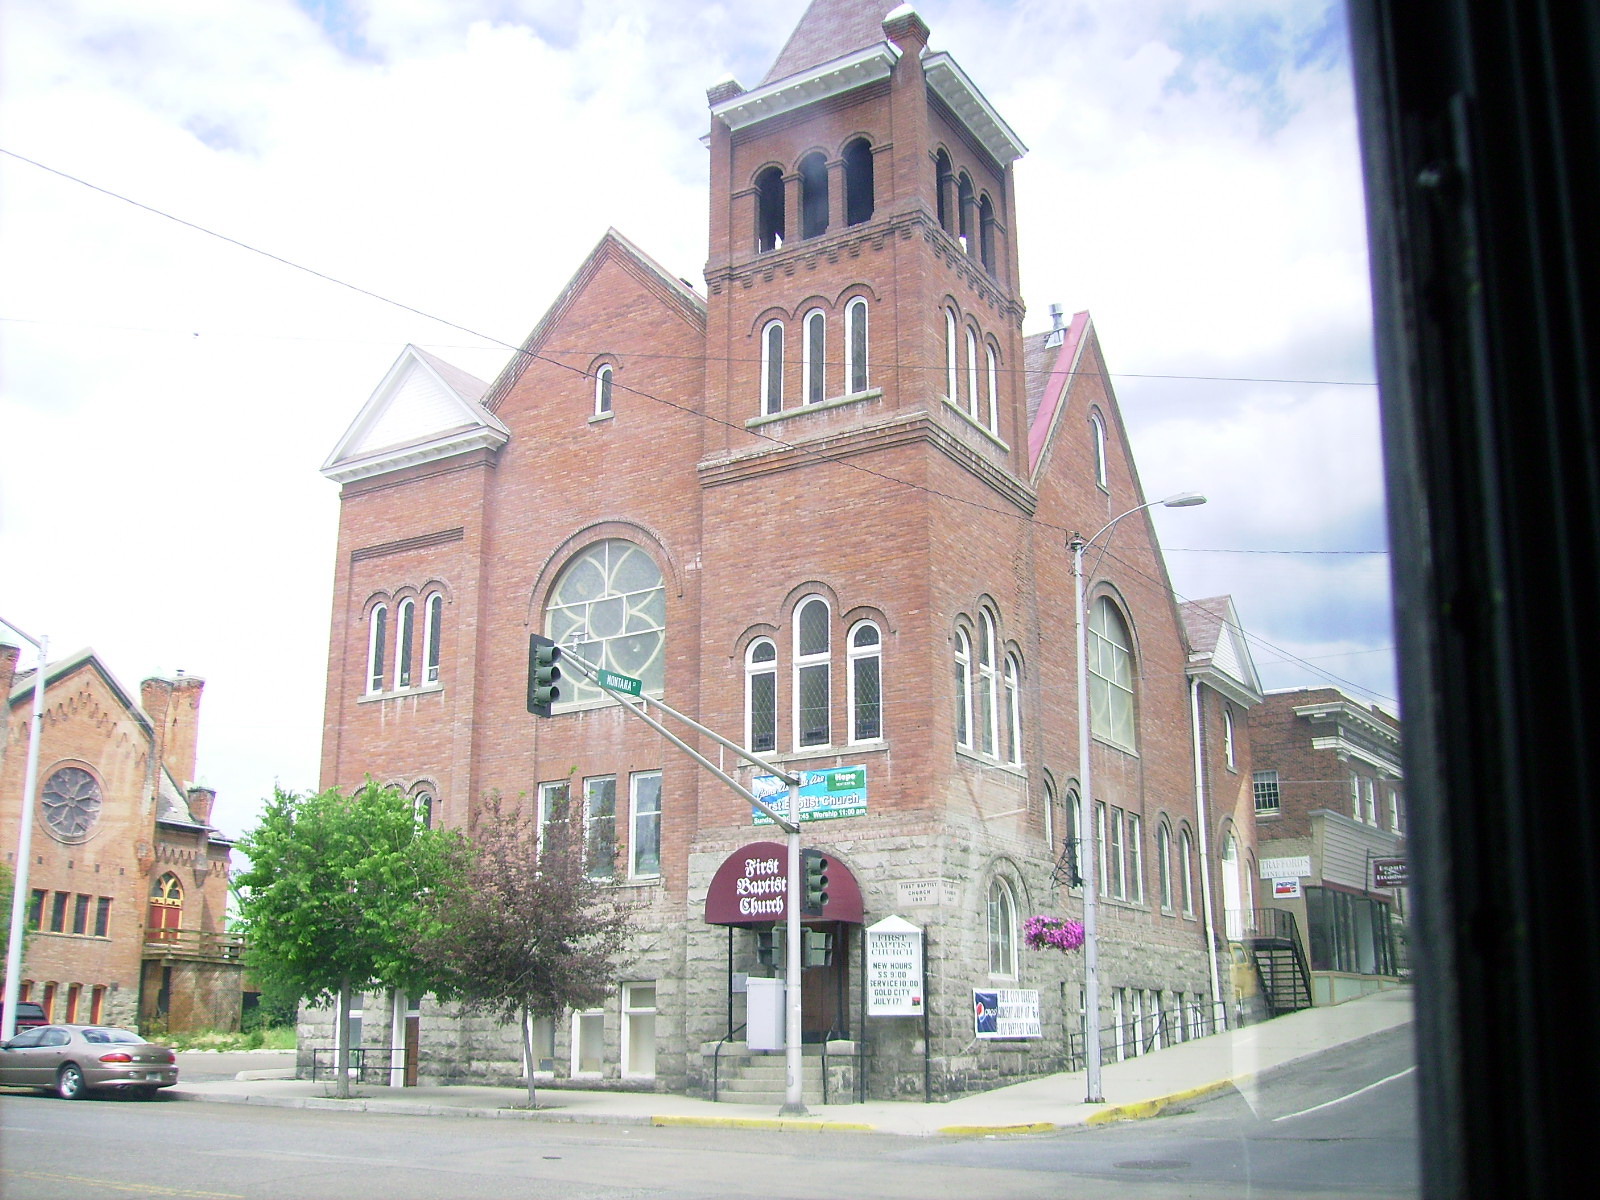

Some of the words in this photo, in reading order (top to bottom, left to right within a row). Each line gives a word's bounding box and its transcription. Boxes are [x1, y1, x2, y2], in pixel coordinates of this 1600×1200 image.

[606, 674, 632, 691] MONTANA
[834, 773, 857, 781] Hope
[784, 796, 820, 811] Bptist
[822, 792, 860, 806] Church
[813, 810, 838, 818] Worship
[839, 808, 855, 816] 11:00
[744, 858, 779, 878] First
[736, 875, 787, 896] Baptist
[739, 895, 784, 917] Church
[878, 934, 907, 942] FIRST
[872, 941, 913, 949] BAPTIST
[870, 980, 898, 988] SERVICE
